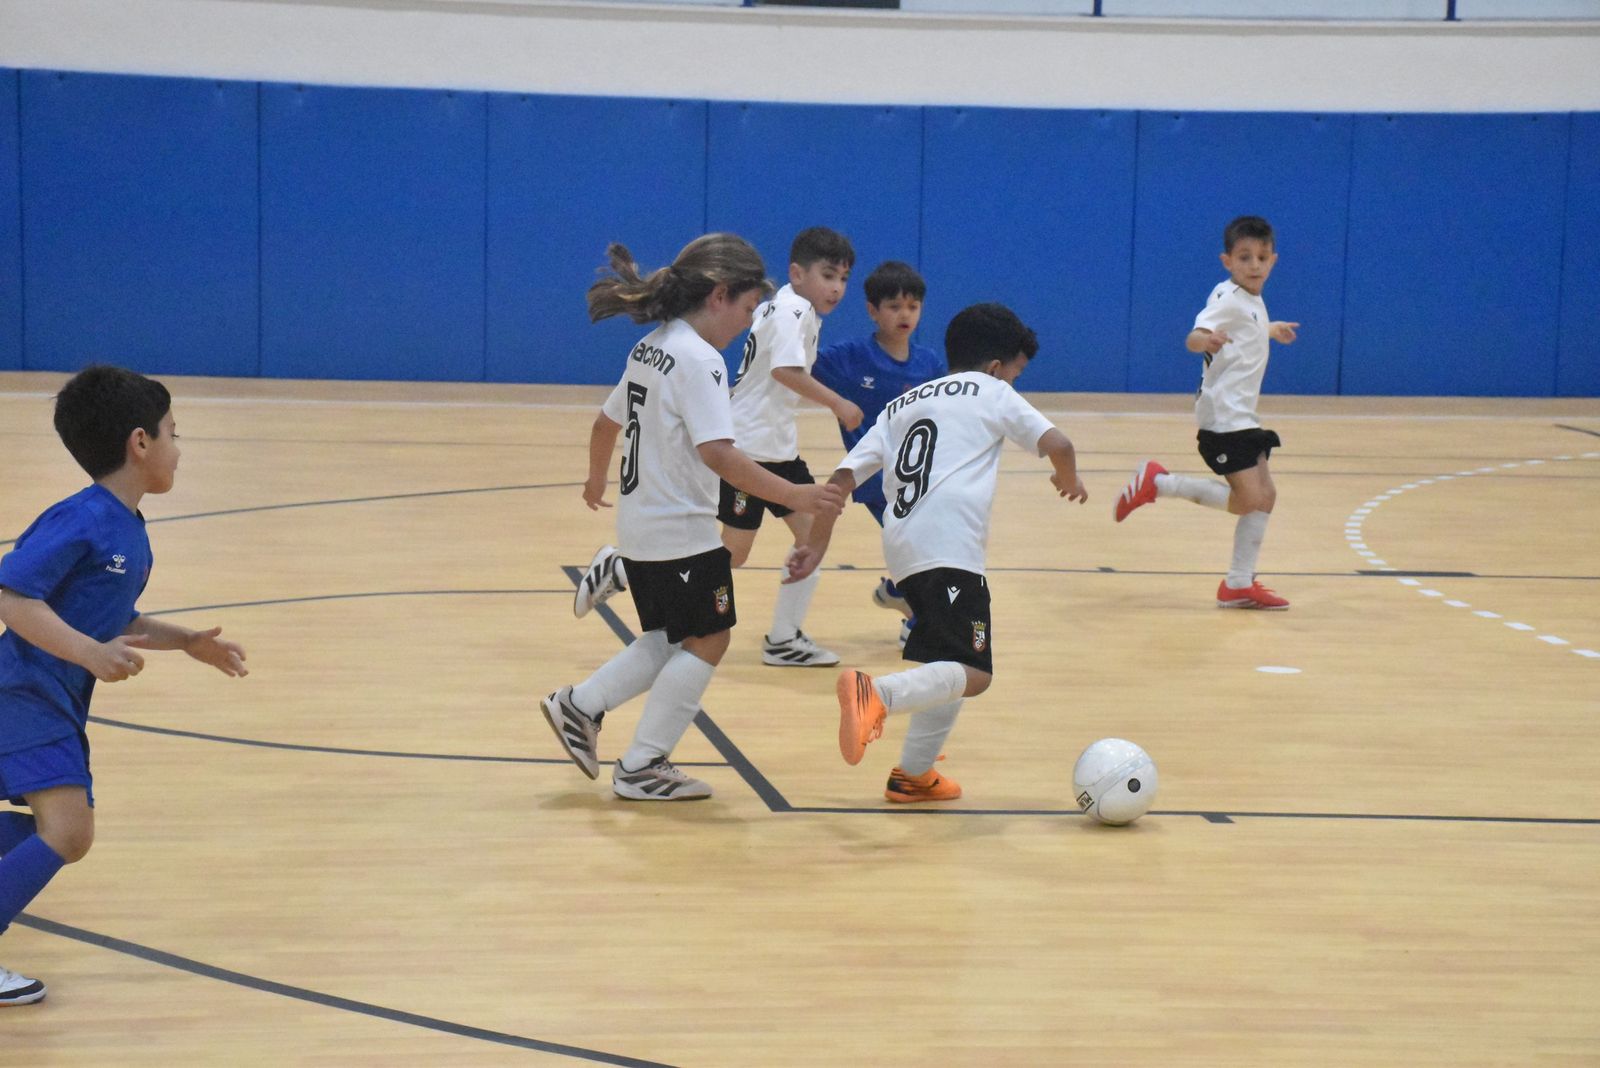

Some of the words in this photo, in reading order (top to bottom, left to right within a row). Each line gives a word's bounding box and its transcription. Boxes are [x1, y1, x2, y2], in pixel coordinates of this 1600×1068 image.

[632, 342, 676, 376] acron
[887, 381, 980, 420] macron
[620, 381, 648, 496] 5
[893, 418, 938, 519] 9
